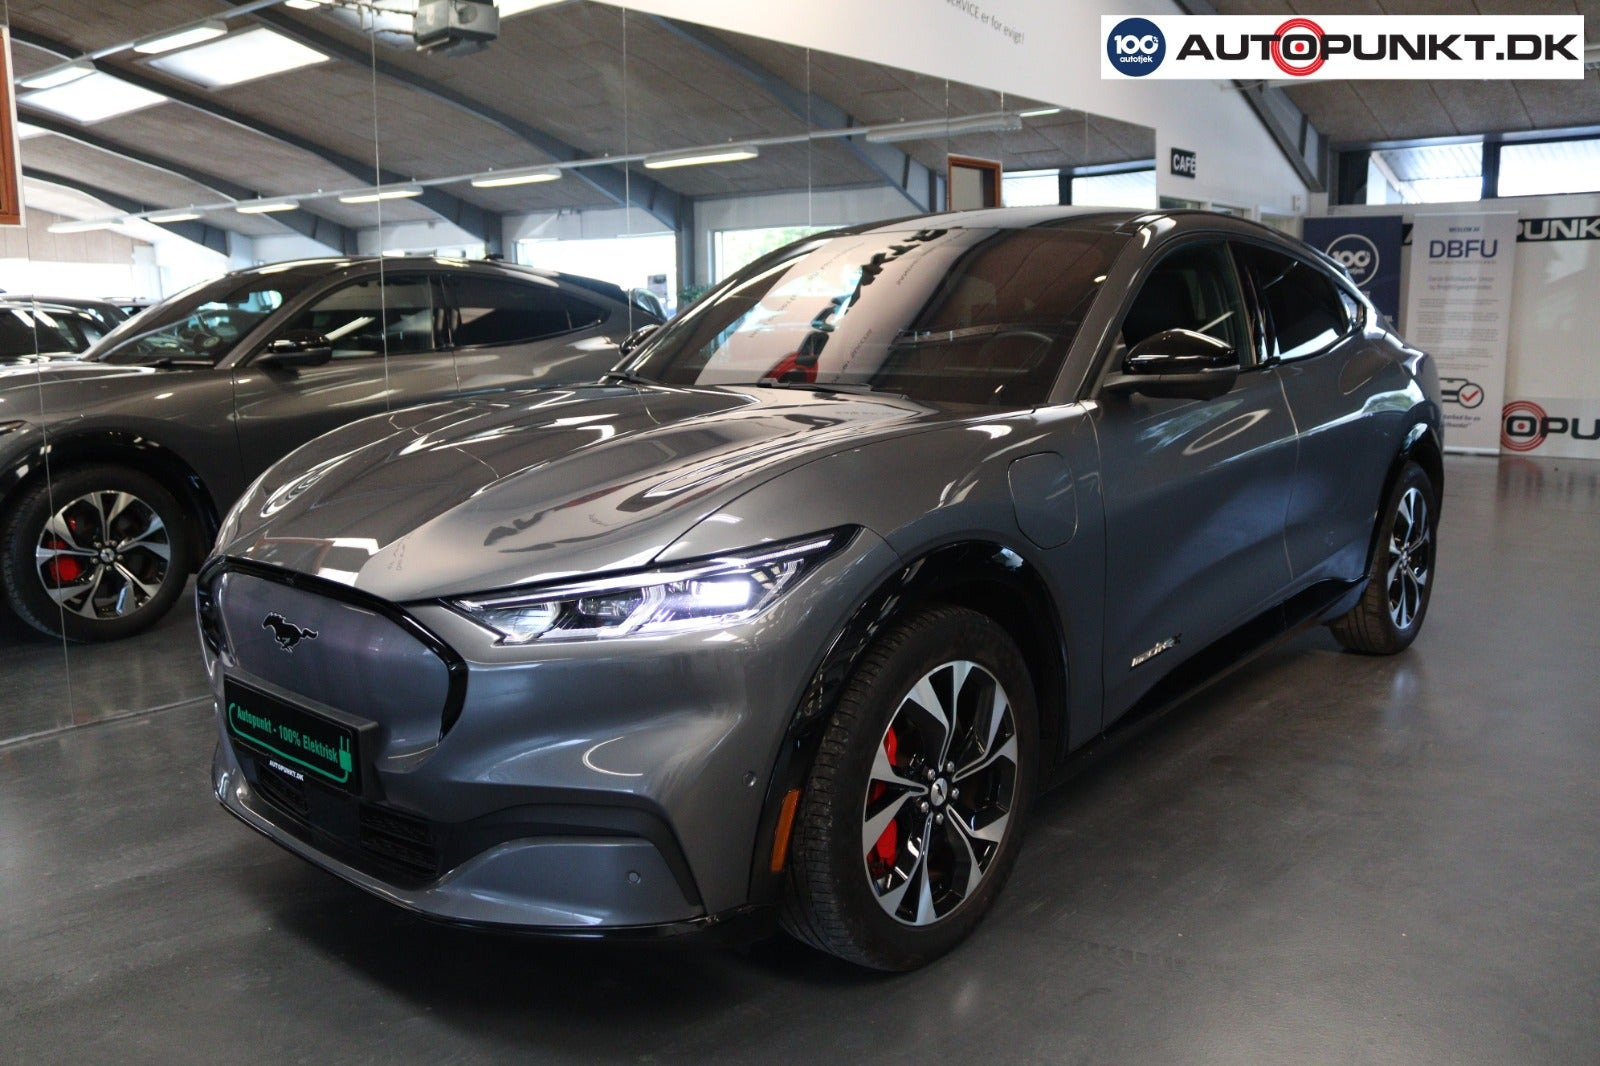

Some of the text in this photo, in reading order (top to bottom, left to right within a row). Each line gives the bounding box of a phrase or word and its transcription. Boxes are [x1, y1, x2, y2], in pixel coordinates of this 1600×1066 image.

[945, 0, 978, 18] ERVICE
[981, 13, 989, 23] er
[992, 15, 1002, 31] for
[1173, 154, 1196, 174] CAFÉ
[1429, 239, 1498, 259] DBFU
[1506, 415, 1600, 441] OPU
[237, 705, 272, 734] Autopunkt
[279, 725, 301, 747] 100%
[302, 734, 338, 764] Elektrisk
[269, 759, 304, 781] AUTOPUNKT.DK
